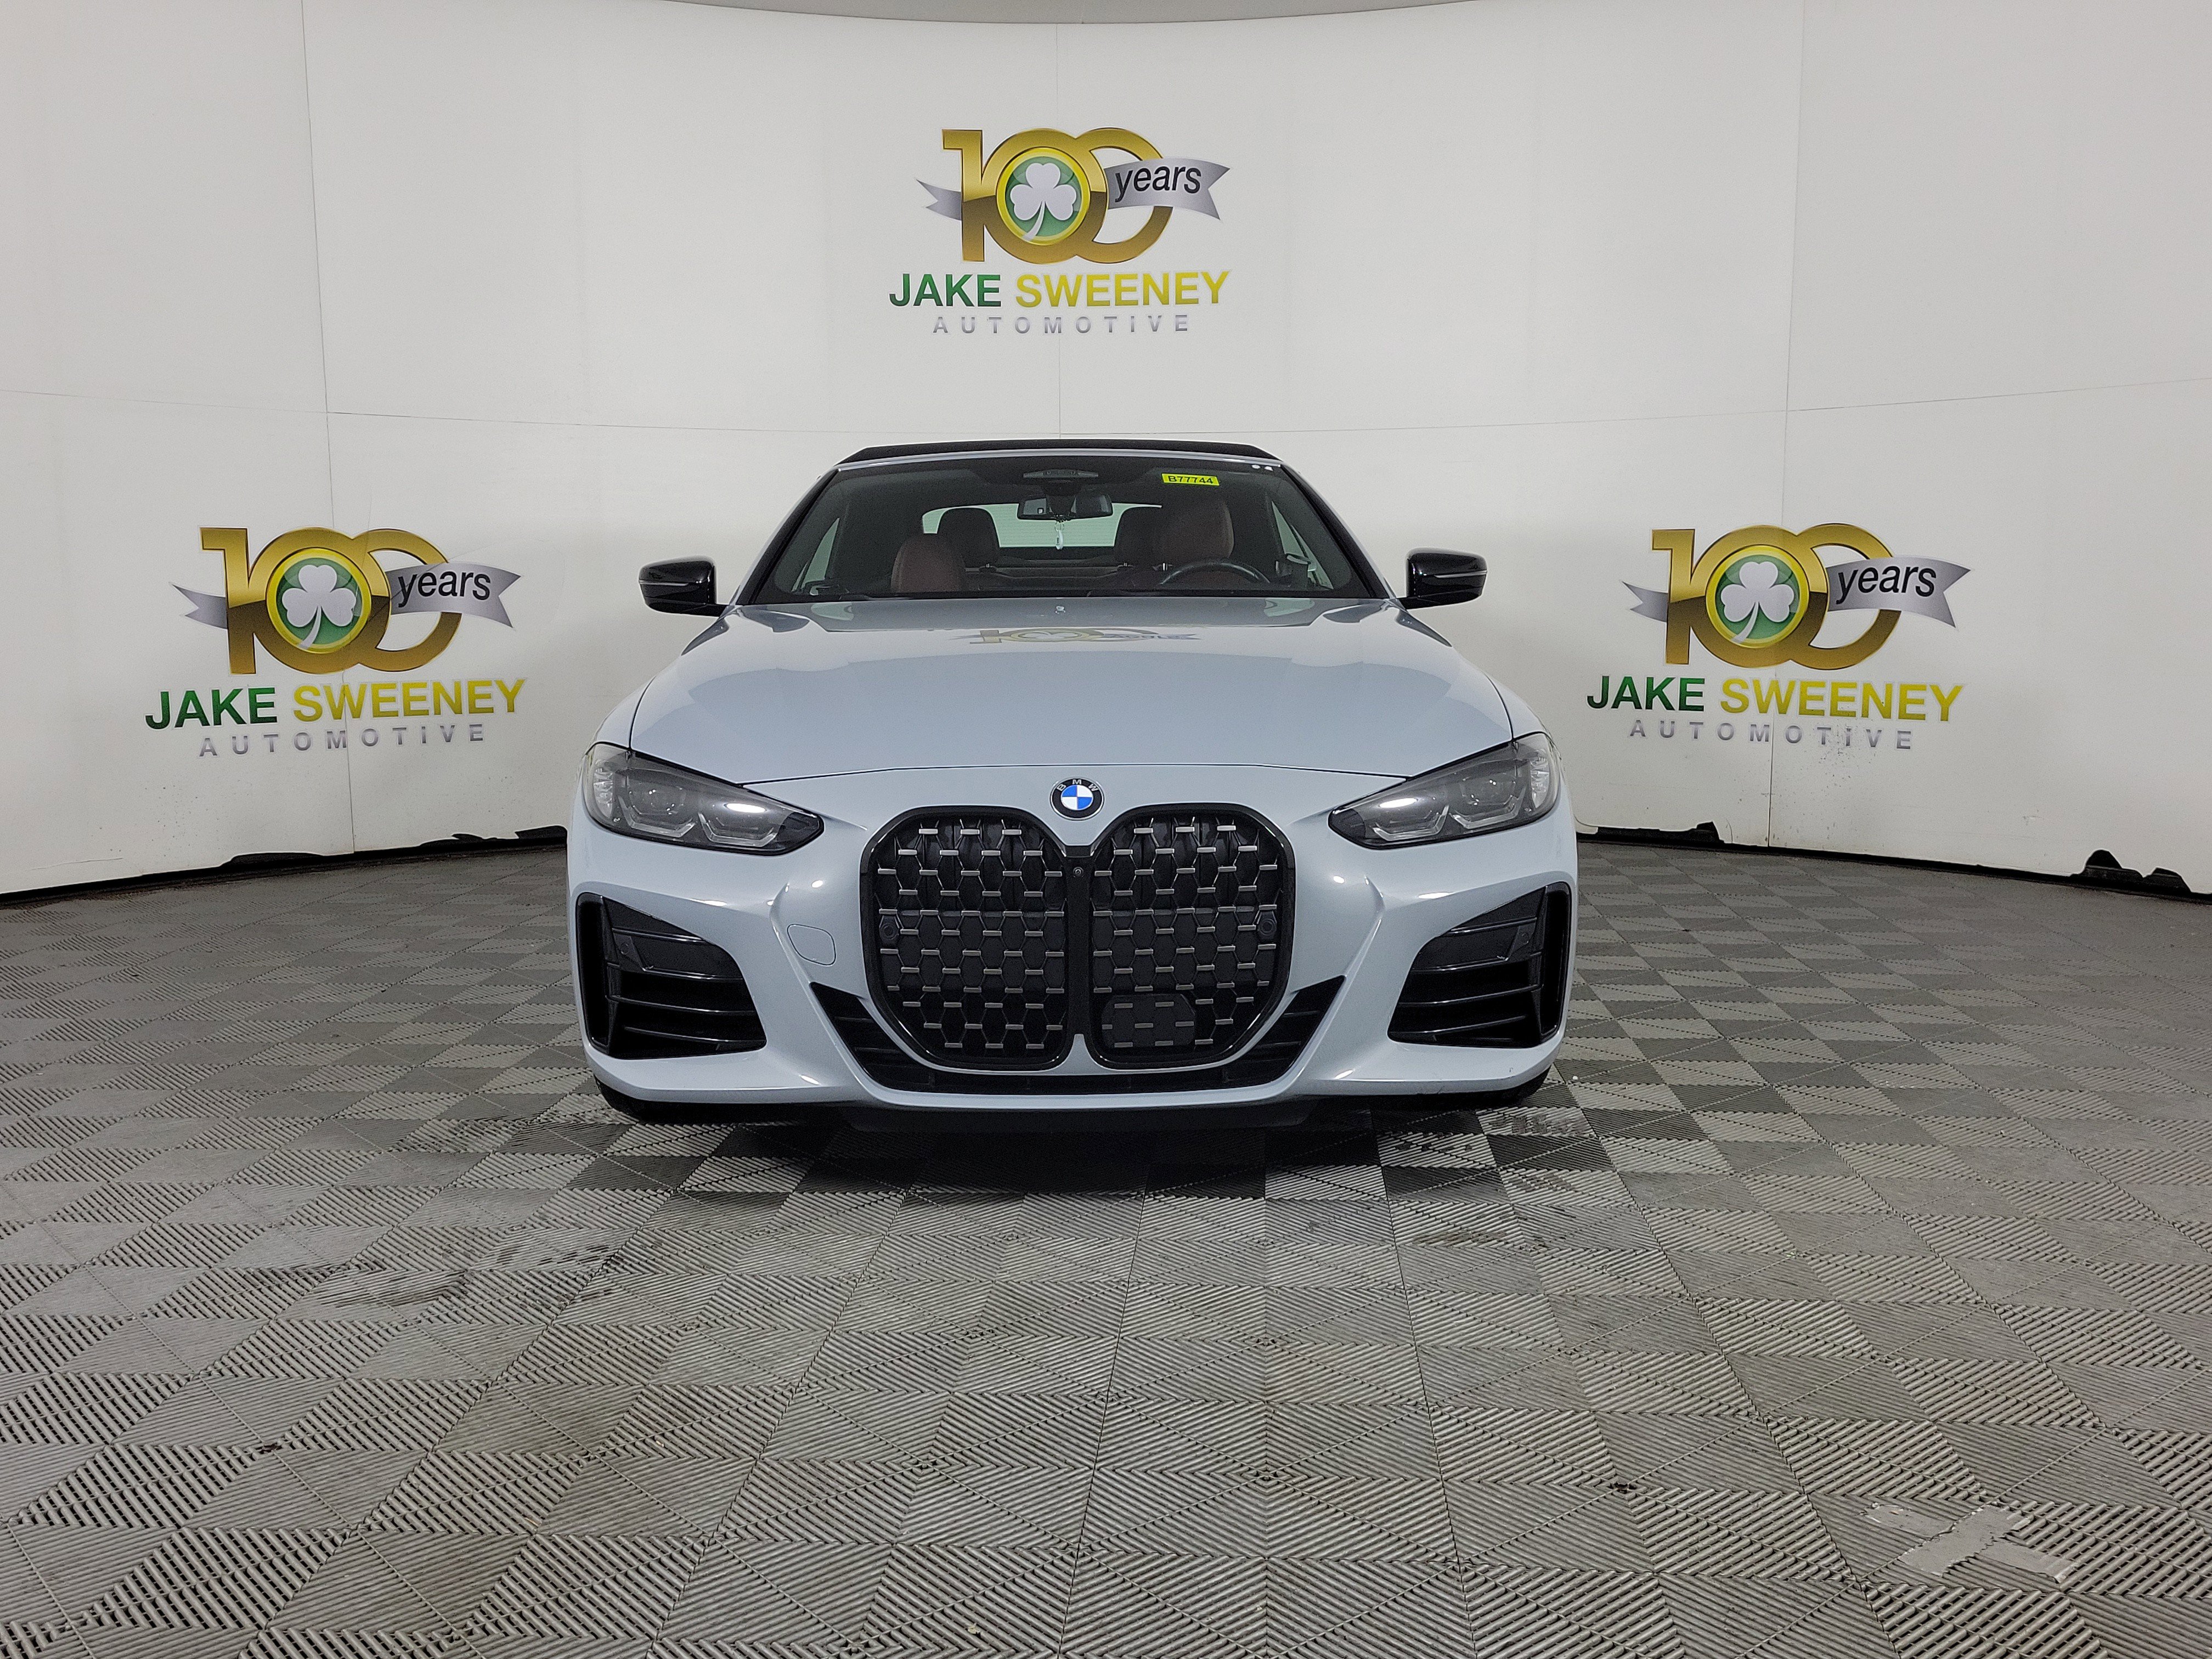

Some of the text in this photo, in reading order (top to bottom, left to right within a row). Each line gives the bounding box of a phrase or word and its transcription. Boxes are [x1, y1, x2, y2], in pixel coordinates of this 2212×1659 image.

[941, 127, 1201, 264] 100 years
[889, 270, 1229, 308] JAKE SWEENEY
[933, 314, 1189, 334] AUTOMOTIVE
[1168, 475, 1213, 484] B77744
[200, 527, 492, 675] 100 years
[1651, 523, 1937, 670] 100 years
[144, 678, 527, 729] JAKE SWEENEY
[1587, 675, 1962, 722] JAKE SWEENEY
[199, 723, 484, 757] AUTOMOTIVE
[1629, 719, 1912, 750] AUTOMOTIVE
[1057, 779, 1099, 792] BMW
